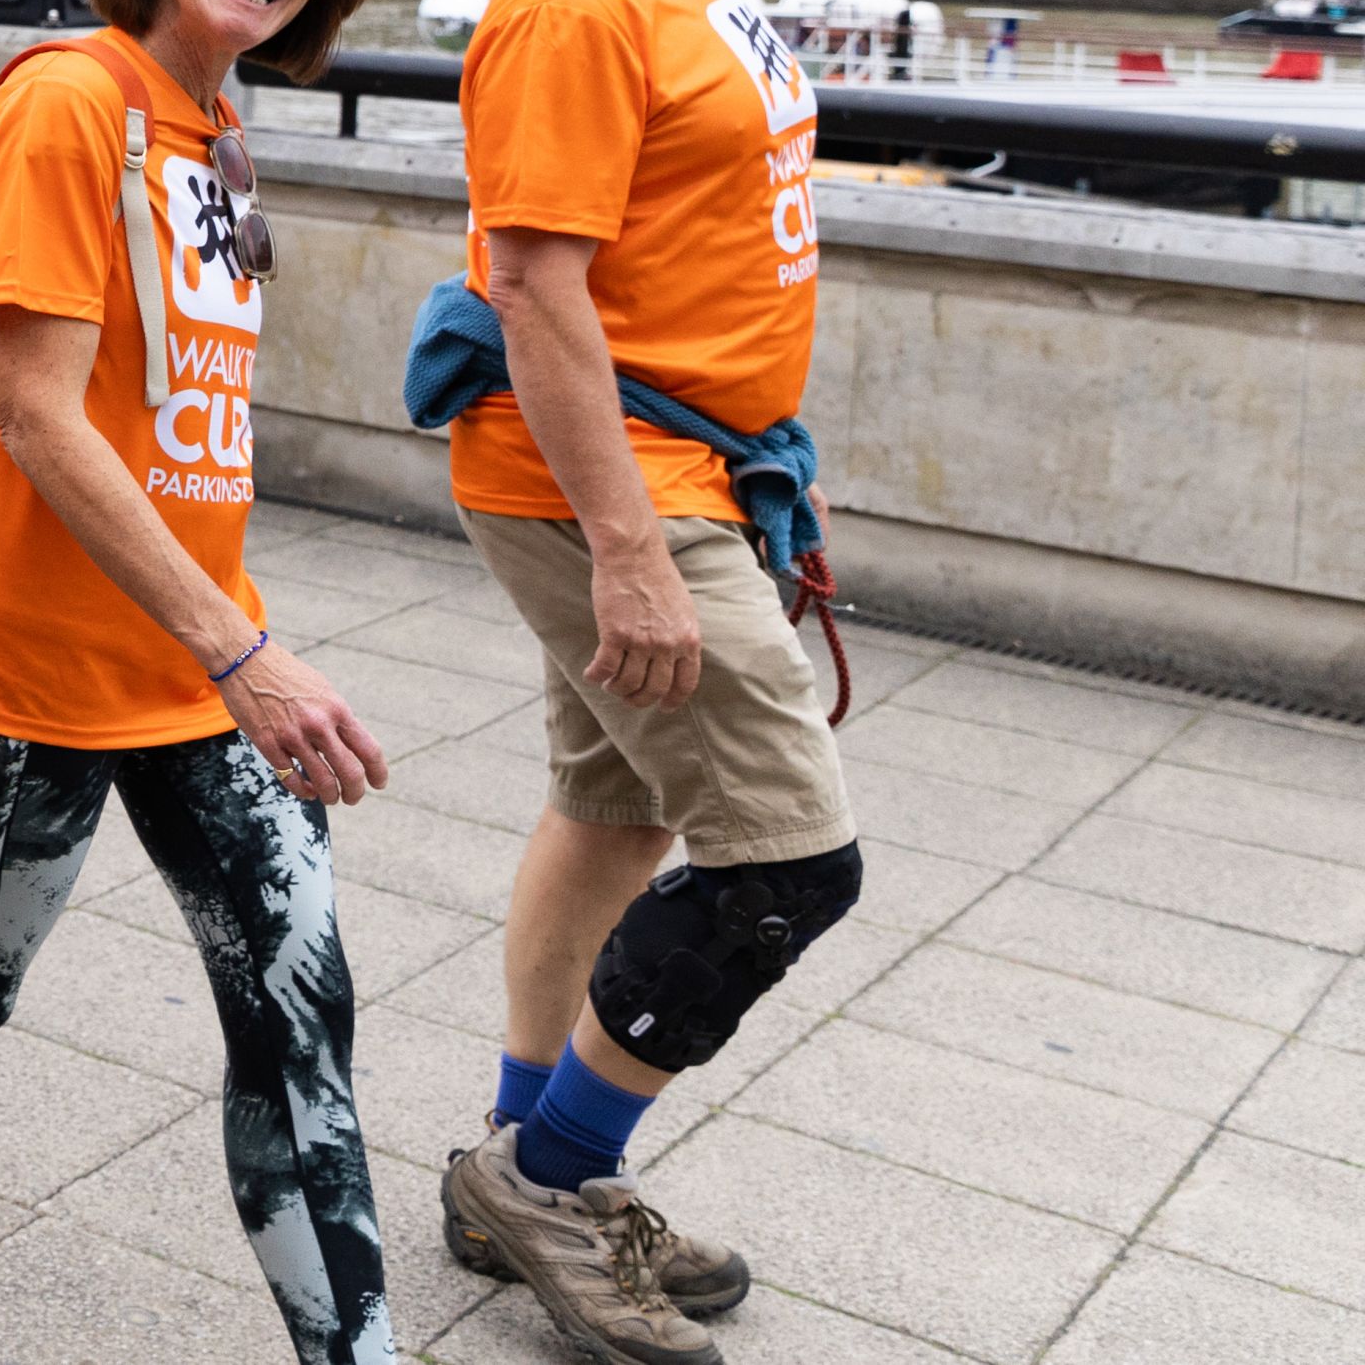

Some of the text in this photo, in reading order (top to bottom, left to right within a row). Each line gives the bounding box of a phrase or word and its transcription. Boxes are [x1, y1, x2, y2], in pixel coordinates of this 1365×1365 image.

[772, 177, 818, 254] CU
[168, 332, 246, 388] WALK
[146, 467, 254, 503] PARKINSO
